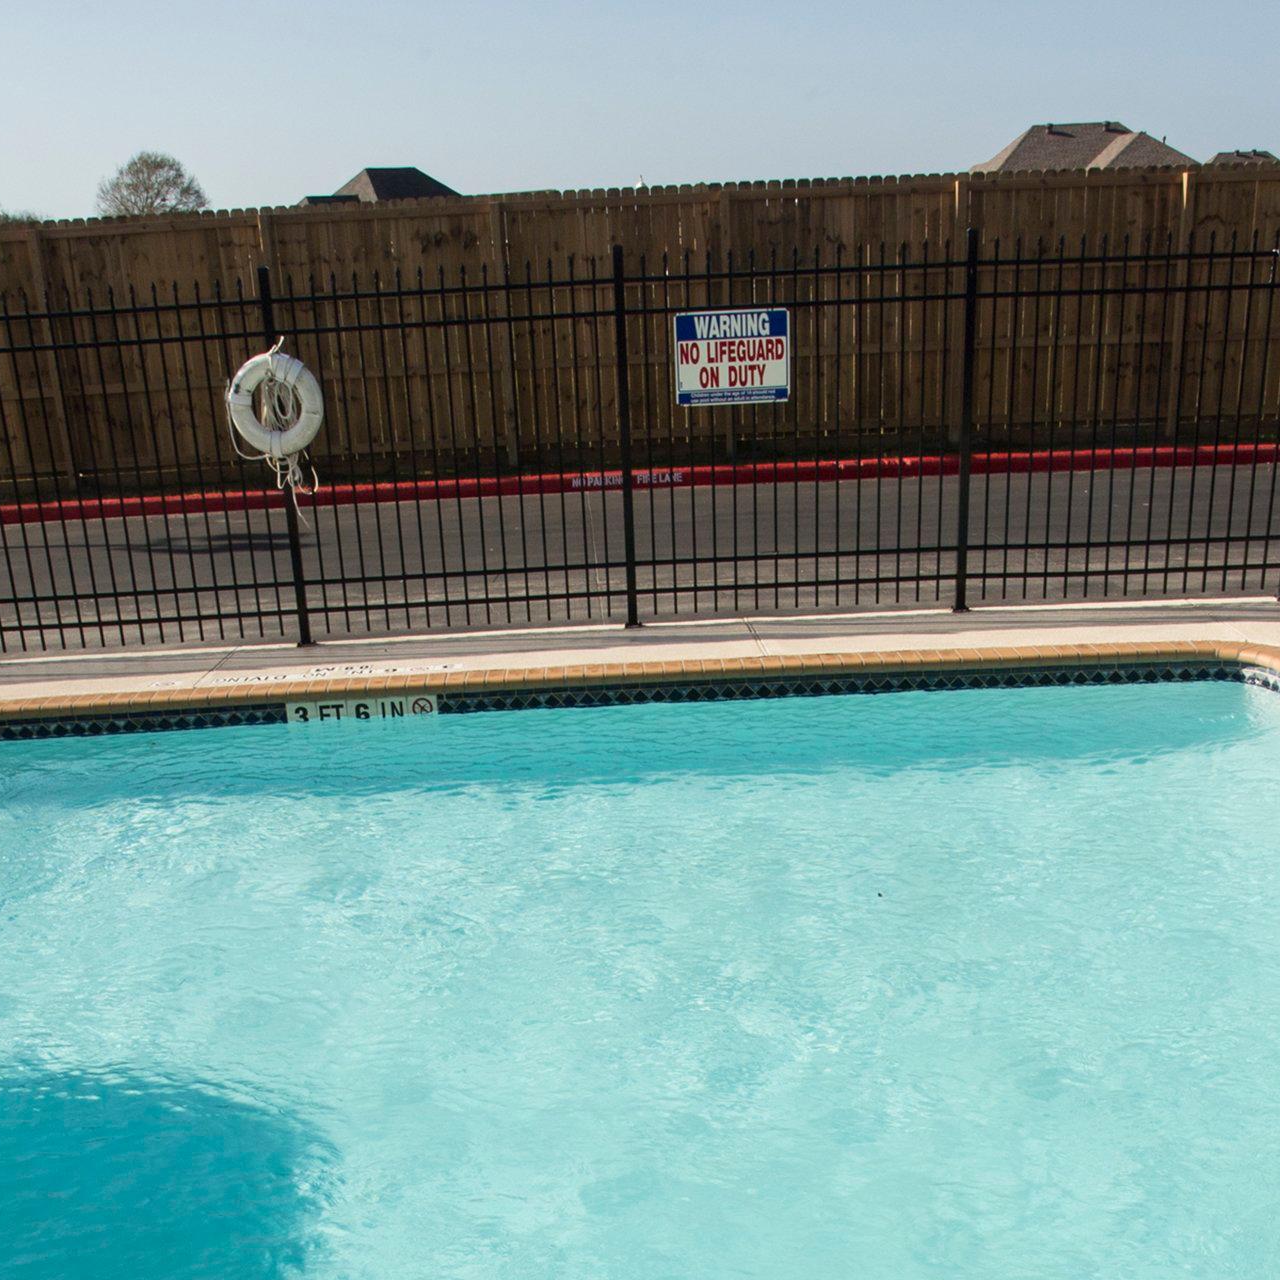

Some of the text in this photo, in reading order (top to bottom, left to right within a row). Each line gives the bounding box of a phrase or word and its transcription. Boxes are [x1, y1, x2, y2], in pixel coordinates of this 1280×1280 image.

[694, 313, 770, 339] WARNING
[680, 338, 785, 365] NO LIFEGUARD
[699, 364, 766, 389] ON DUTY
[294, 701, 405, 722] 3 FT 6 IN
